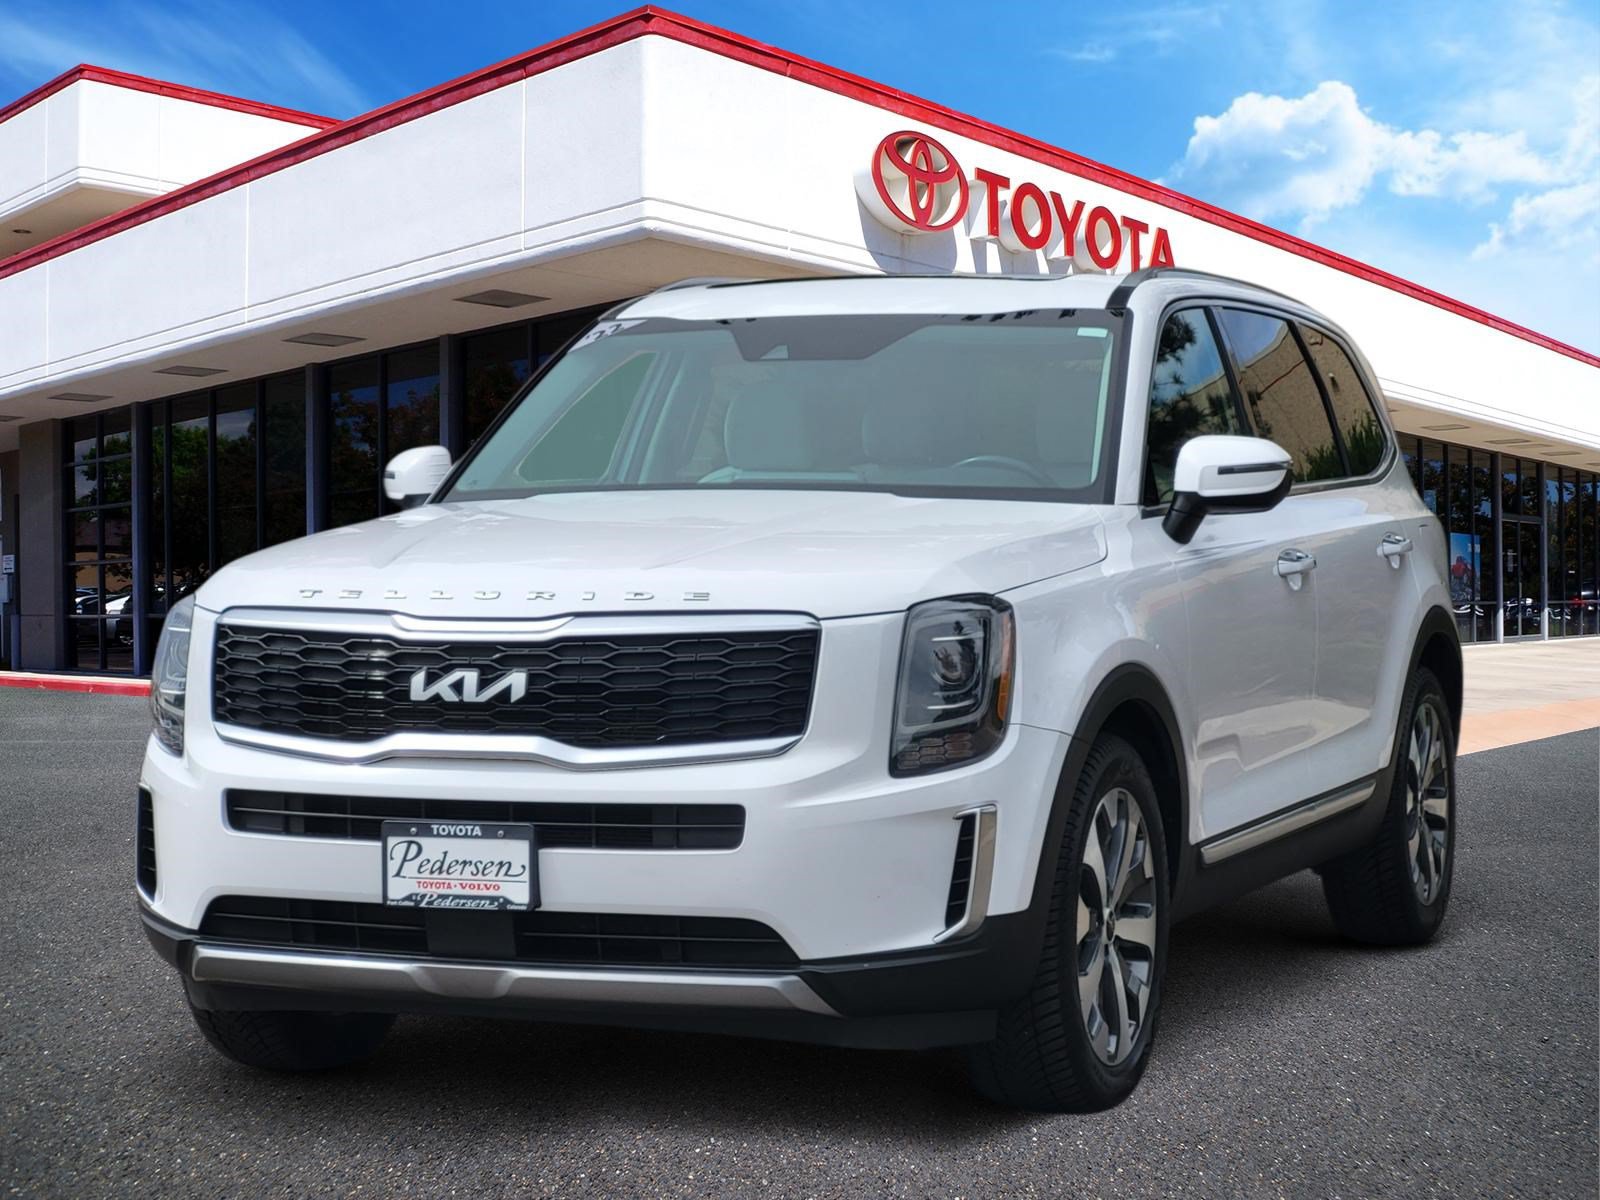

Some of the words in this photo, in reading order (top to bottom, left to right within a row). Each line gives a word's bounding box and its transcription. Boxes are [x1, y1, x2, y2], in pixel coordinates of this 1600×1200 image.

[975, 167, 1176, 273] TOYOTA
[299, 589, 711, 601] TELLURIDE
[431, 825, 482, 836] TOYOTA
[389, 840, 527, 879] Pedersen
[416, 880, 453, 890] TOYOTA
[459, 882, 501, 892] VOLVO
[417, 892, 499, 909] Pedersen
